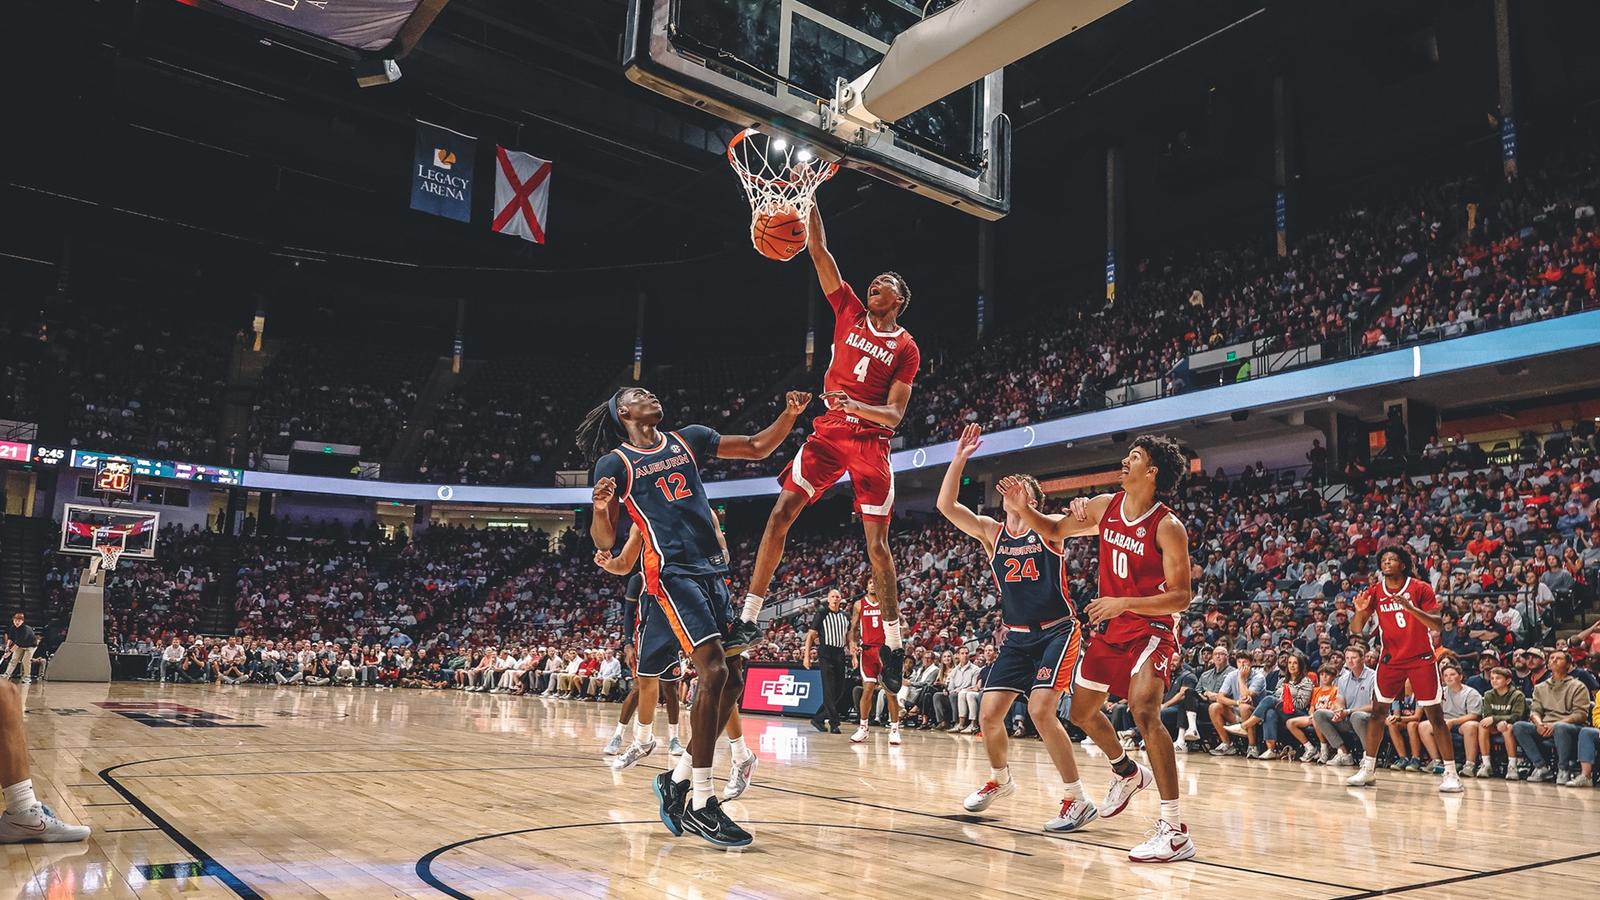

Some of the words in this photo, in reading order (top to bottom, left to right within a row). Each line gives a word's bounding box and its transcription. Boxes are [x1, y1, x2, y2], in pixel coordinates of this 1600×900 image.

[418, 164, 469, 189] LEGACY
[420, 181, 464, 201] ARENA
[845, 332, 895, 367] ALABAMA
[853, 355, 871, 383] 4
[0, 446, 18, 458] 21
[37, 447, 65, 459] 9:45
[635, 453, 690, 479] AUBURN
[101, 471, 125, 490] 20
[655, 472, 693, 502] 12
[997, 543, 1043, 556] AUBURN
[1103, 528, 1145, 557] ALABAMA
[1004, 557, 1040, 582] 24
[1112, 549, 1129, 579] 10
[1380, 602, 1404, 613] ALABA
[872, 616, 879, 629] 5
[1395, 612, 1407, 629] 6
